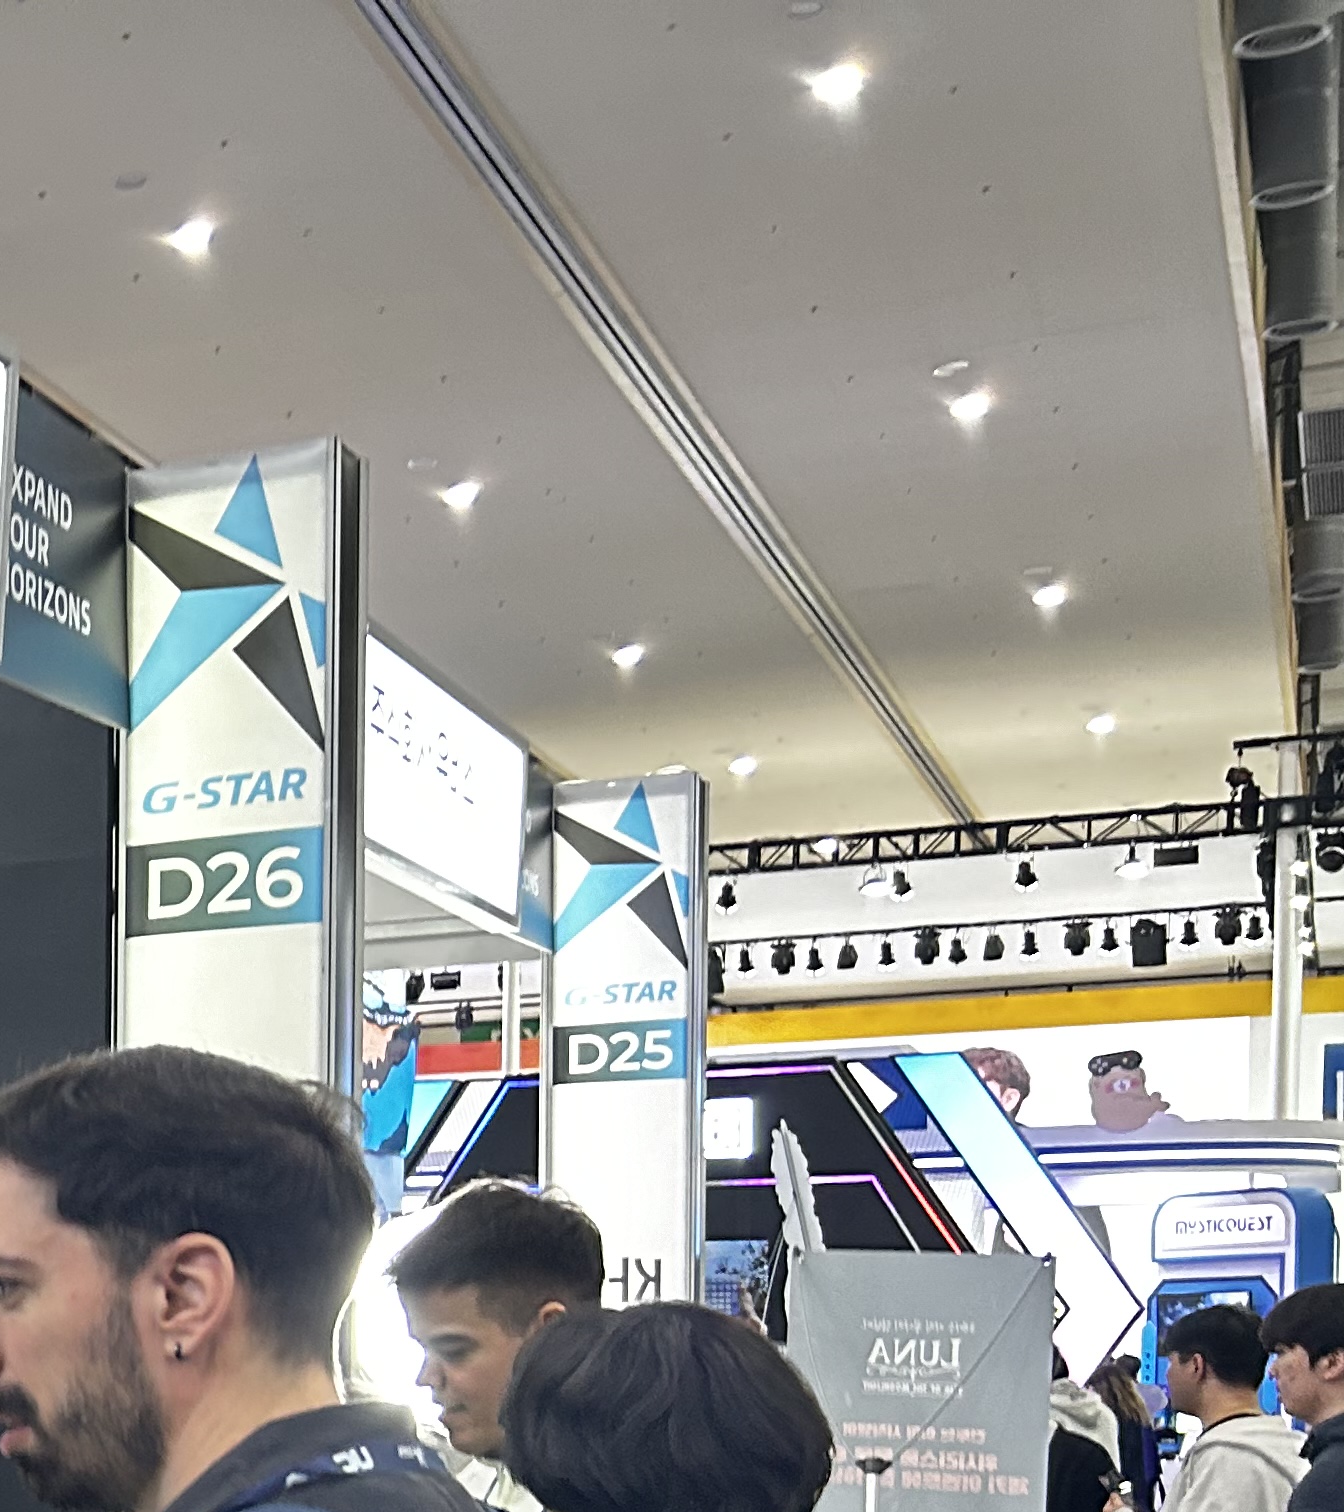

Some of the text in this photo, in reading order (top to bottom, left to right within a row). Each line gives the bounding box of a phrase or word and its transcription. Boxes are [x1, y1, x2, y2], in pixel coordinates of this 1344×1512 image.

[11, 463, 73, 531] XPAND
[10, 512, 49, 568] OUR
[141, 767, 308, 815] G-STAR
[146, 846, 305, 921] D26
[567, 1029, 675, 1076] D25
